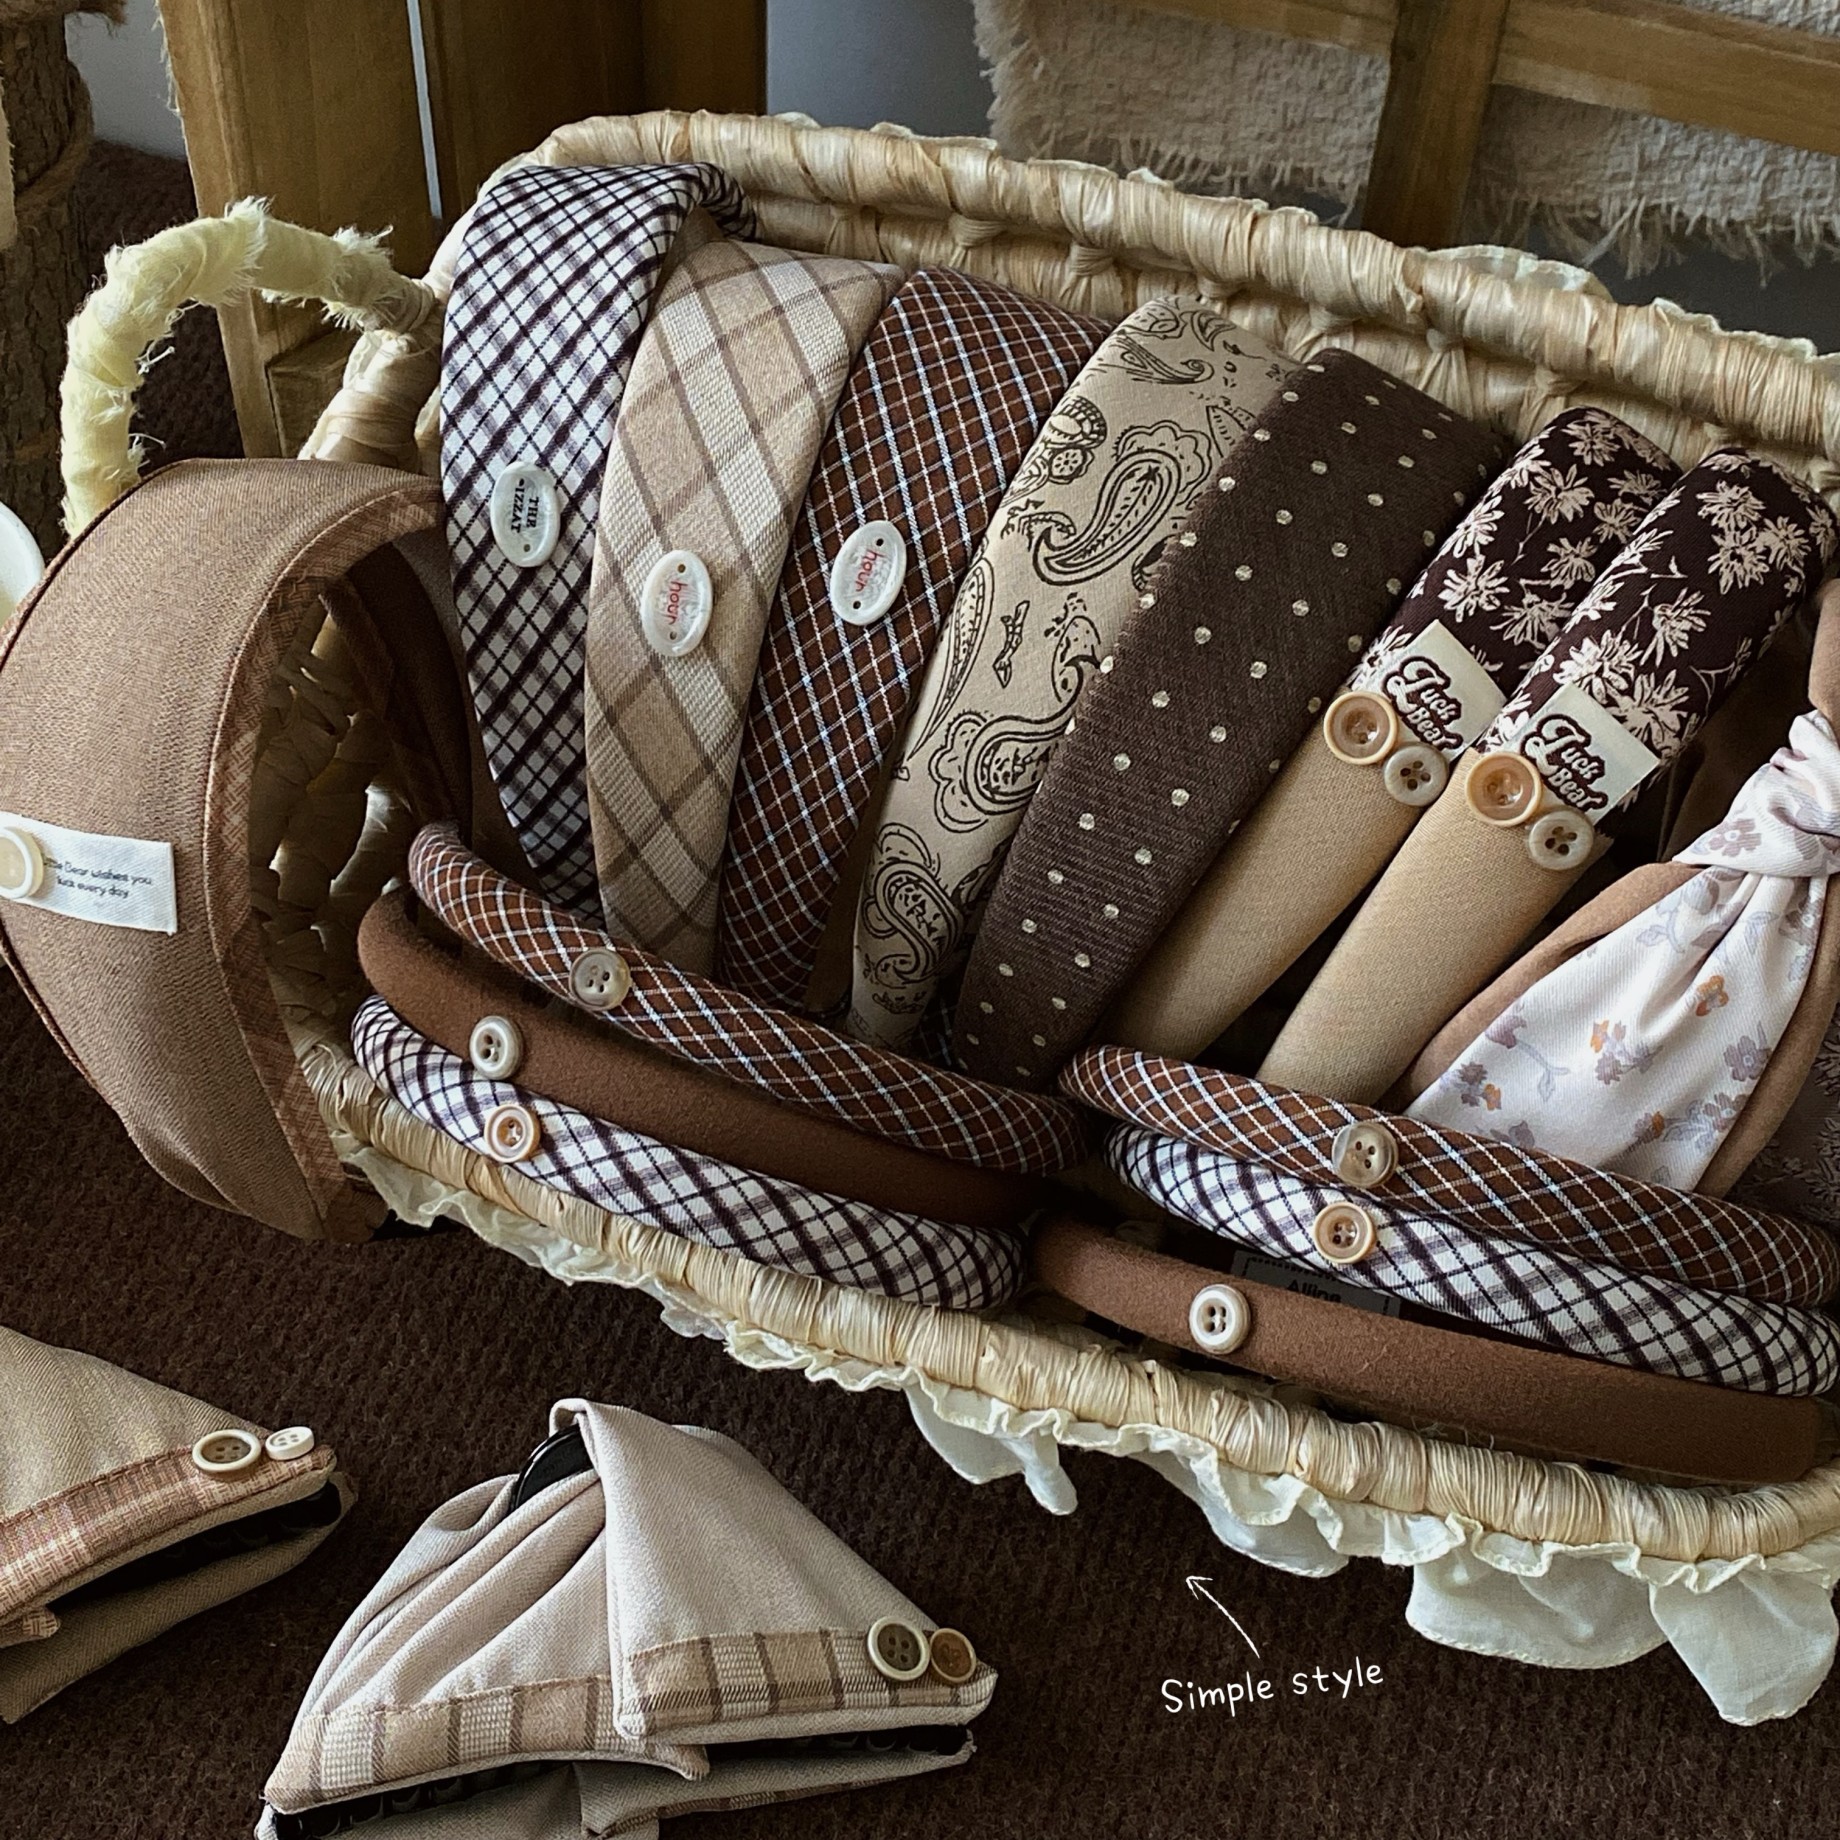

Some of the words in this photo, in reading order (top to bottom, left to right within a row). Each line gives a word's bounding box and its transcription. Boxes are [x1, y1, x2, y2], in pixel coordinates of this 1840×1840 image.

[511, 486, 525, 533] IZZAT
[855, 548, 888, 592] hour
[661, 581, 688, 625] hour
[1405, 705, 1461, 748] Bear
[1546, 766, 1608, 809] Bear
[77, 882, 107, 896] every
[109, 886, 129, 899] day
